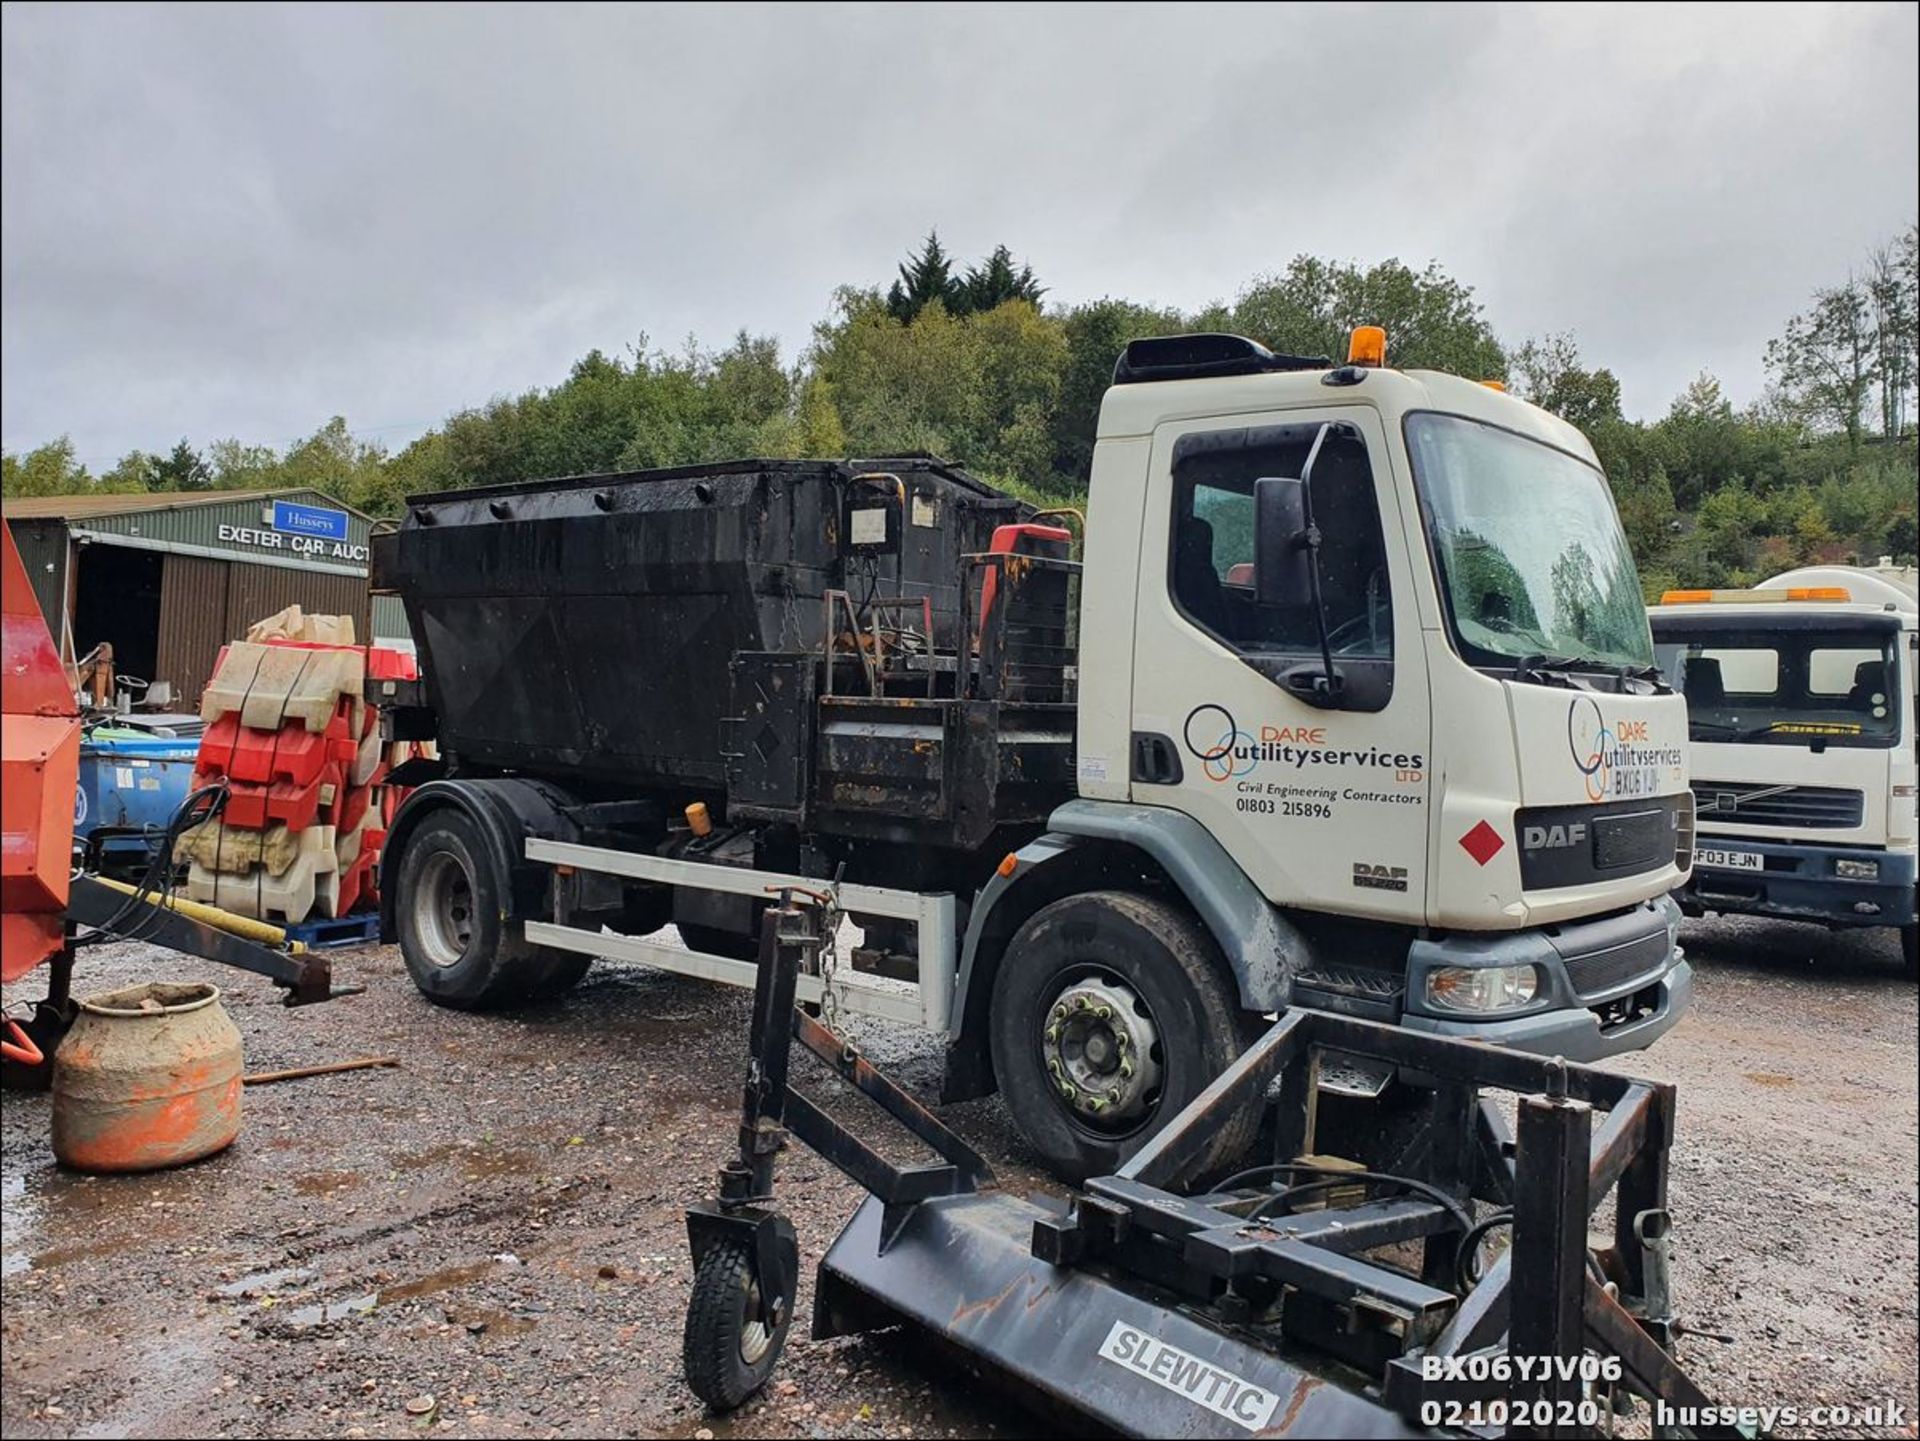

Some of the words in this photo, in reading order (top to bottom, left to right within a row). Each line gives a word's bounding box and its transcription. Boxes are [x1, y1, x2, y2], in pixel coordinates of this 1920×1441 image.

[288, 511, 334, 530] Husseys
[218, 525, 281, 548] EXETER
[292, 537, 324, 554] CAR
[1261, 726, 1327, 745] DARE
[1617, 721, 1649, 742] DARE
[1235, 742, 1423, 769] utilityservices
[1395, 769, 1422, 783] LTD
[1237, 781, 1263, 793] Civil
[1267, 783, 1338, 801] Engineering
[1343, 788, 1422, 804] Contractors
[1236, 798, 1275, 814] 01803
[1282, 801, 1331, 819] 215896
[1524, 824, 1586, 849] DAF
[1728, 853, 1757, 867] EJN
[1112, 1330, 1265, 1422] SLEWTIC
